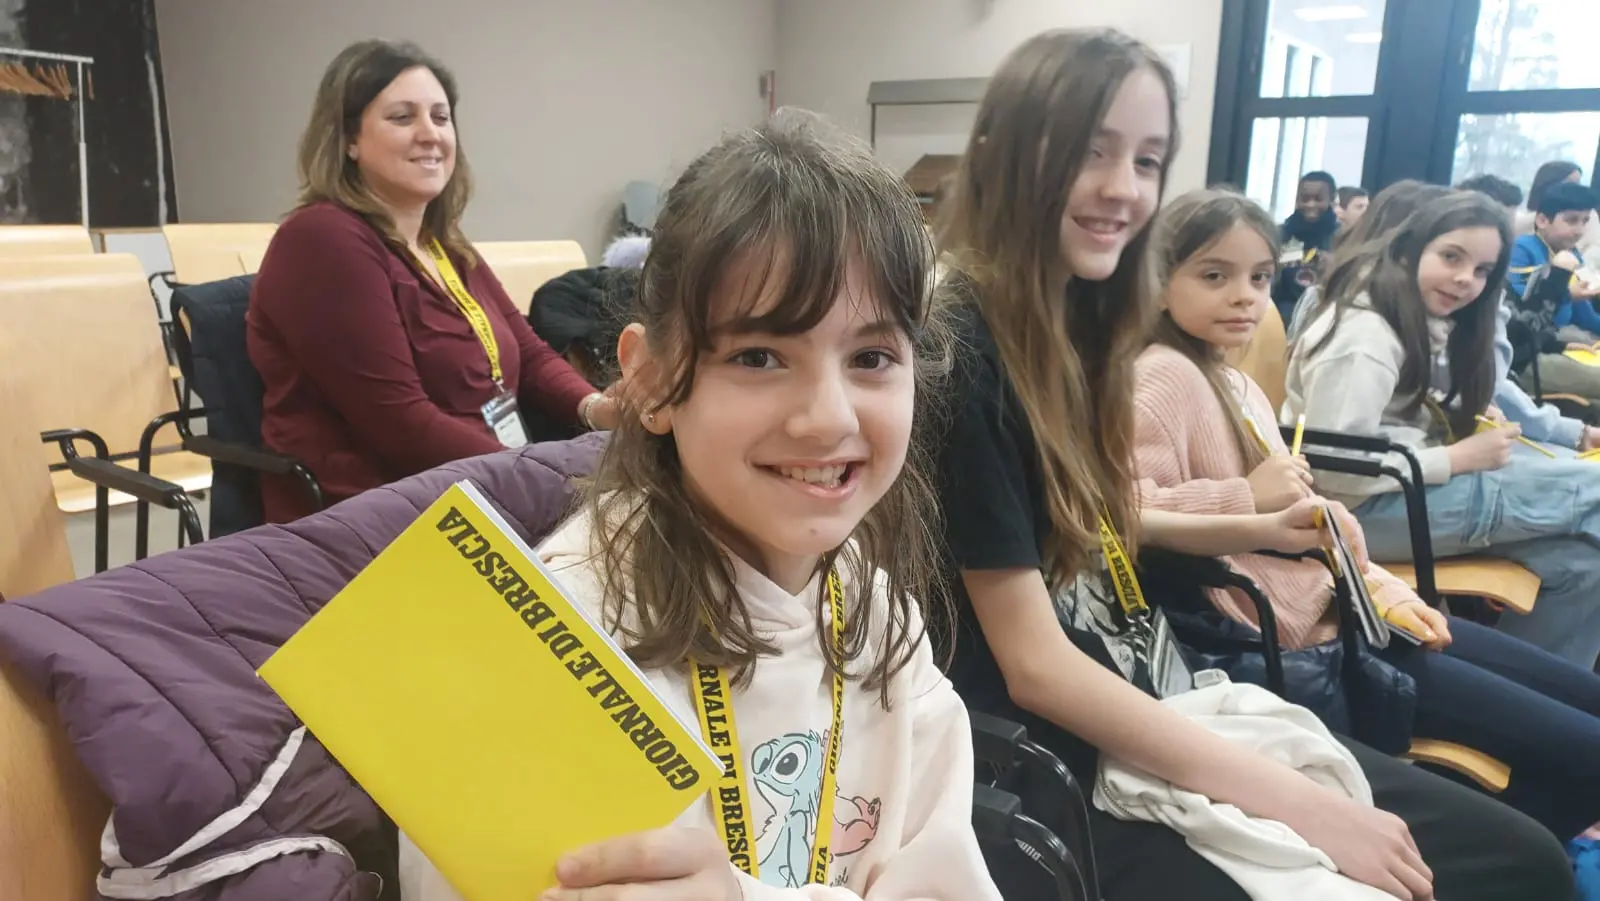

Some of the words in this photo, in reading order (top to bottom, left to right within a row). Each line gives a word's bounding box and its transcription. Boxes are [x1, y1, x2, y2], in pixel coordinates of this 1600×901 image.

[436, 506, 556, 630] BRESCIA
[537, 621, 584, 660] DI
[565, 651, 700, 791] GIORNALE
